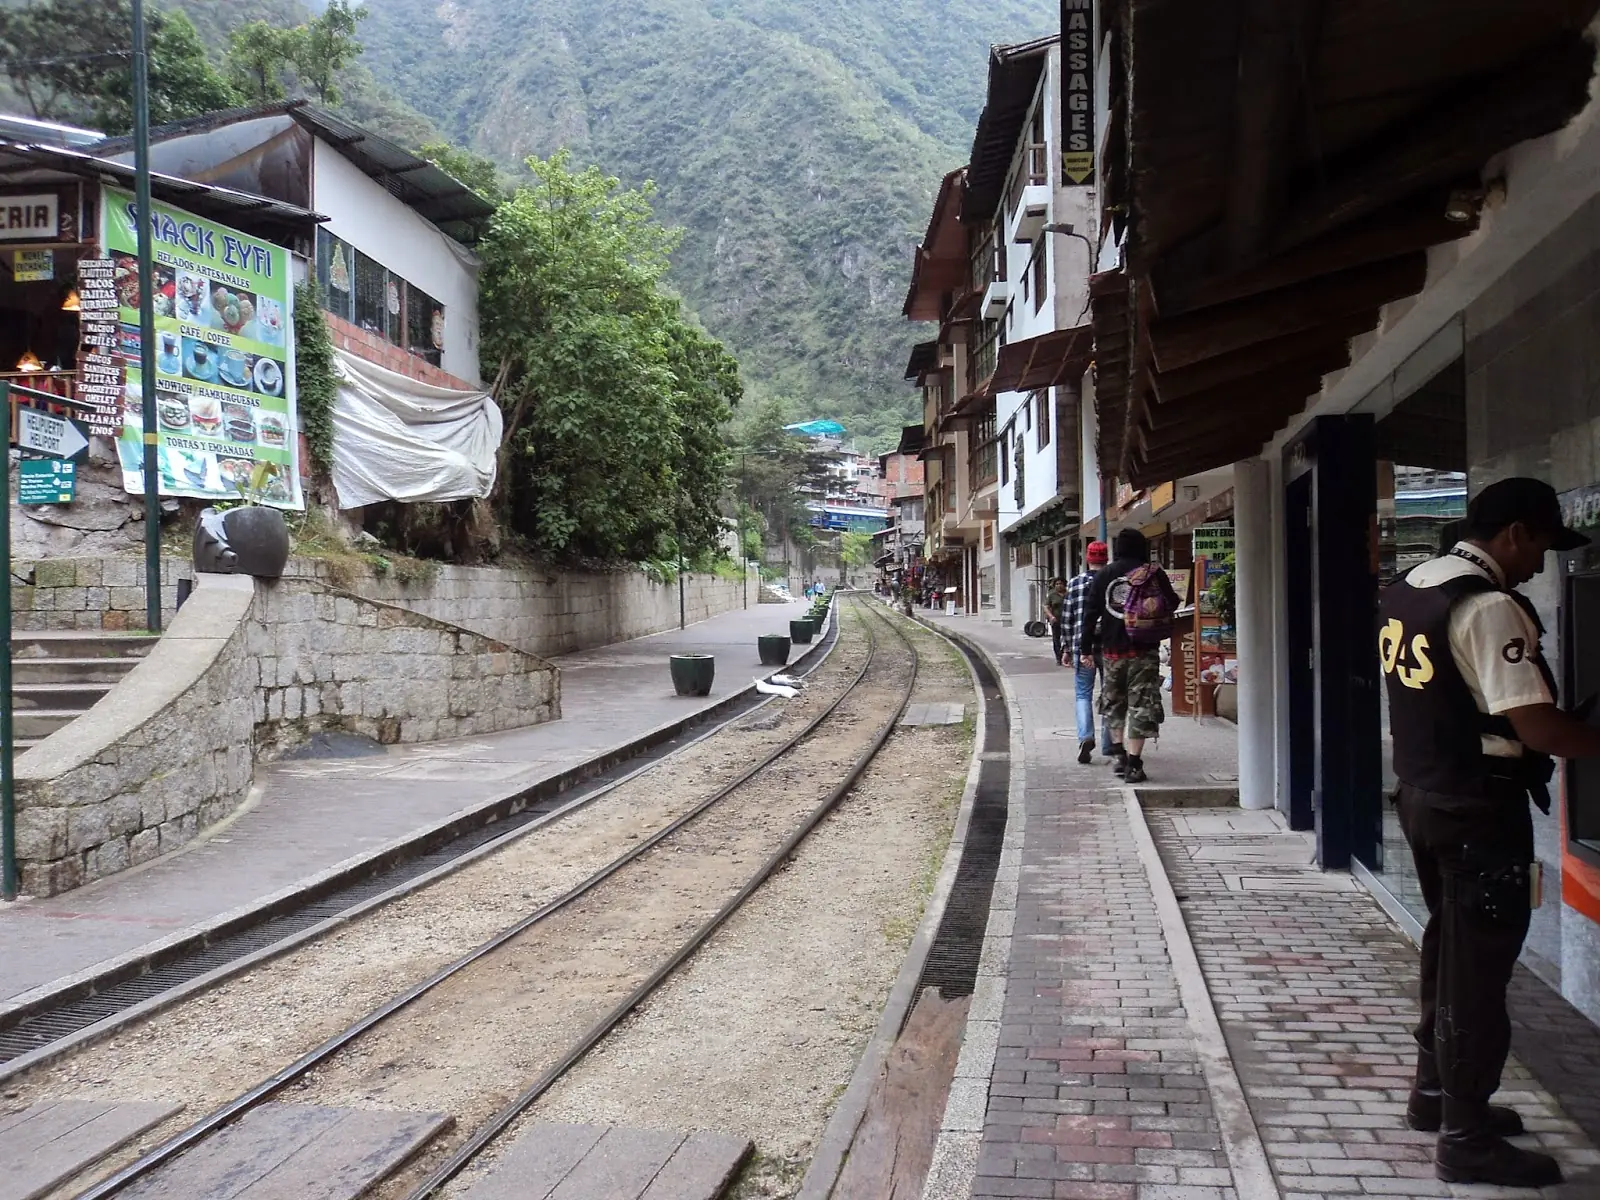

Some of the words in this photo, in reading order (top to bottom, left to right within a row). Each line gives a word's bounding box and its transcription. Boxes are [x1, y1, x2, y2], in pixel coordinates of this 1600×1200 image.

[1066, 0, 1089, 150] MASSAGES
[222, 234, 272, 279] EYFI
[157, 250, 194, 271] HELADOS
[196, 264, 250, 289] ARTESANALES
[84, 280, 115, 289] TACOS
[80, 289, 117, 299] FAJITAS
[80, 300, 119, 310] BURRITOS
[80, 312, 119, 321] ENCHILADAS
[86, 323, 116, 334] NACHOS
[180, 324, 201, 339] CAFÉ
[207, 332, 231, 346] COFEE
[84, 335, 118, 348] CHILES
[84, 374, 119, 385] PIZZAS
[78, 384, 121, 396] SPAGHETTIS
[85, 394, 117, 405] OMELET
[199, 387, 261, 408] HAMBURGUESAS
[27, 414, 65, 438] HELIPUERTO
[30, 431, 61, 451] HELIPORT
[166, 436, 200, 451] TORTAS
[201, 440, 207, 452] Y
[208, 441, 254, 458] EMPANADAS
[1195, 528, 1218, 537] MONEY
[1195, 540, 1218, 549] EUROS
[1181, 631, 1198, 705] CUSQUEÑA
